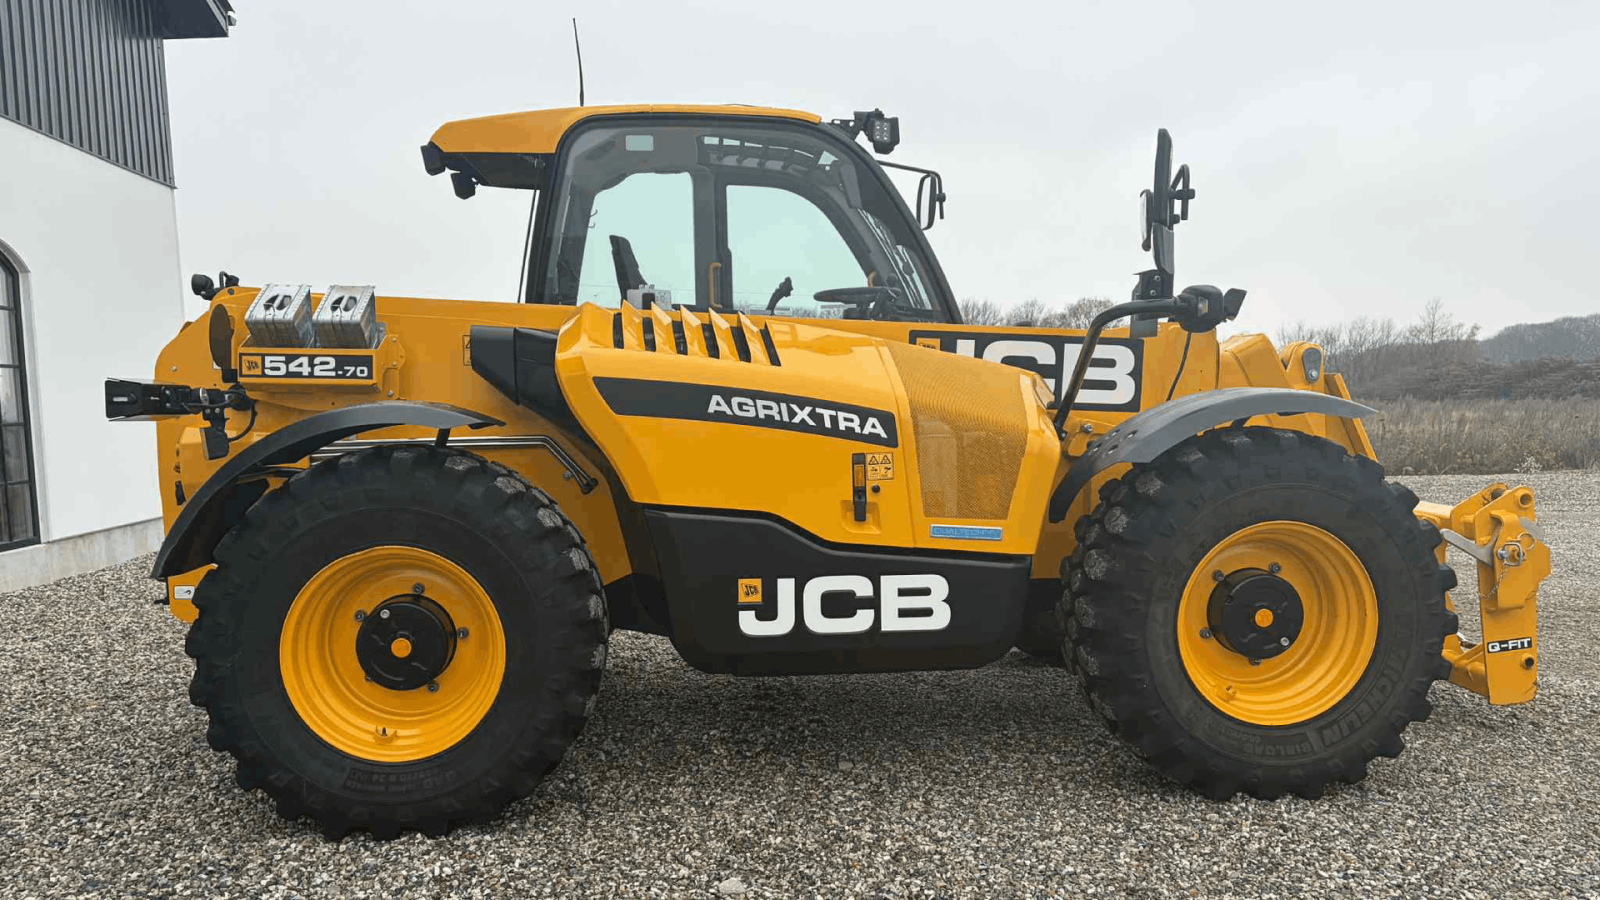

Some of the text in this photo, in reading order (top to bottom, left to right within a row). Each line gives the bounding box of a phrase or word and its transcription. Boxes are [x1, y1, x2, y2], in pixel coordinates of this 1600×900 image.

[264, 355, 369, 377] 542-70
[707, 394, 888, 439] AGRIXTRA
[738, 574, 951, 636] JCB
[1488, 637, 1531, 652] Q-FIT
